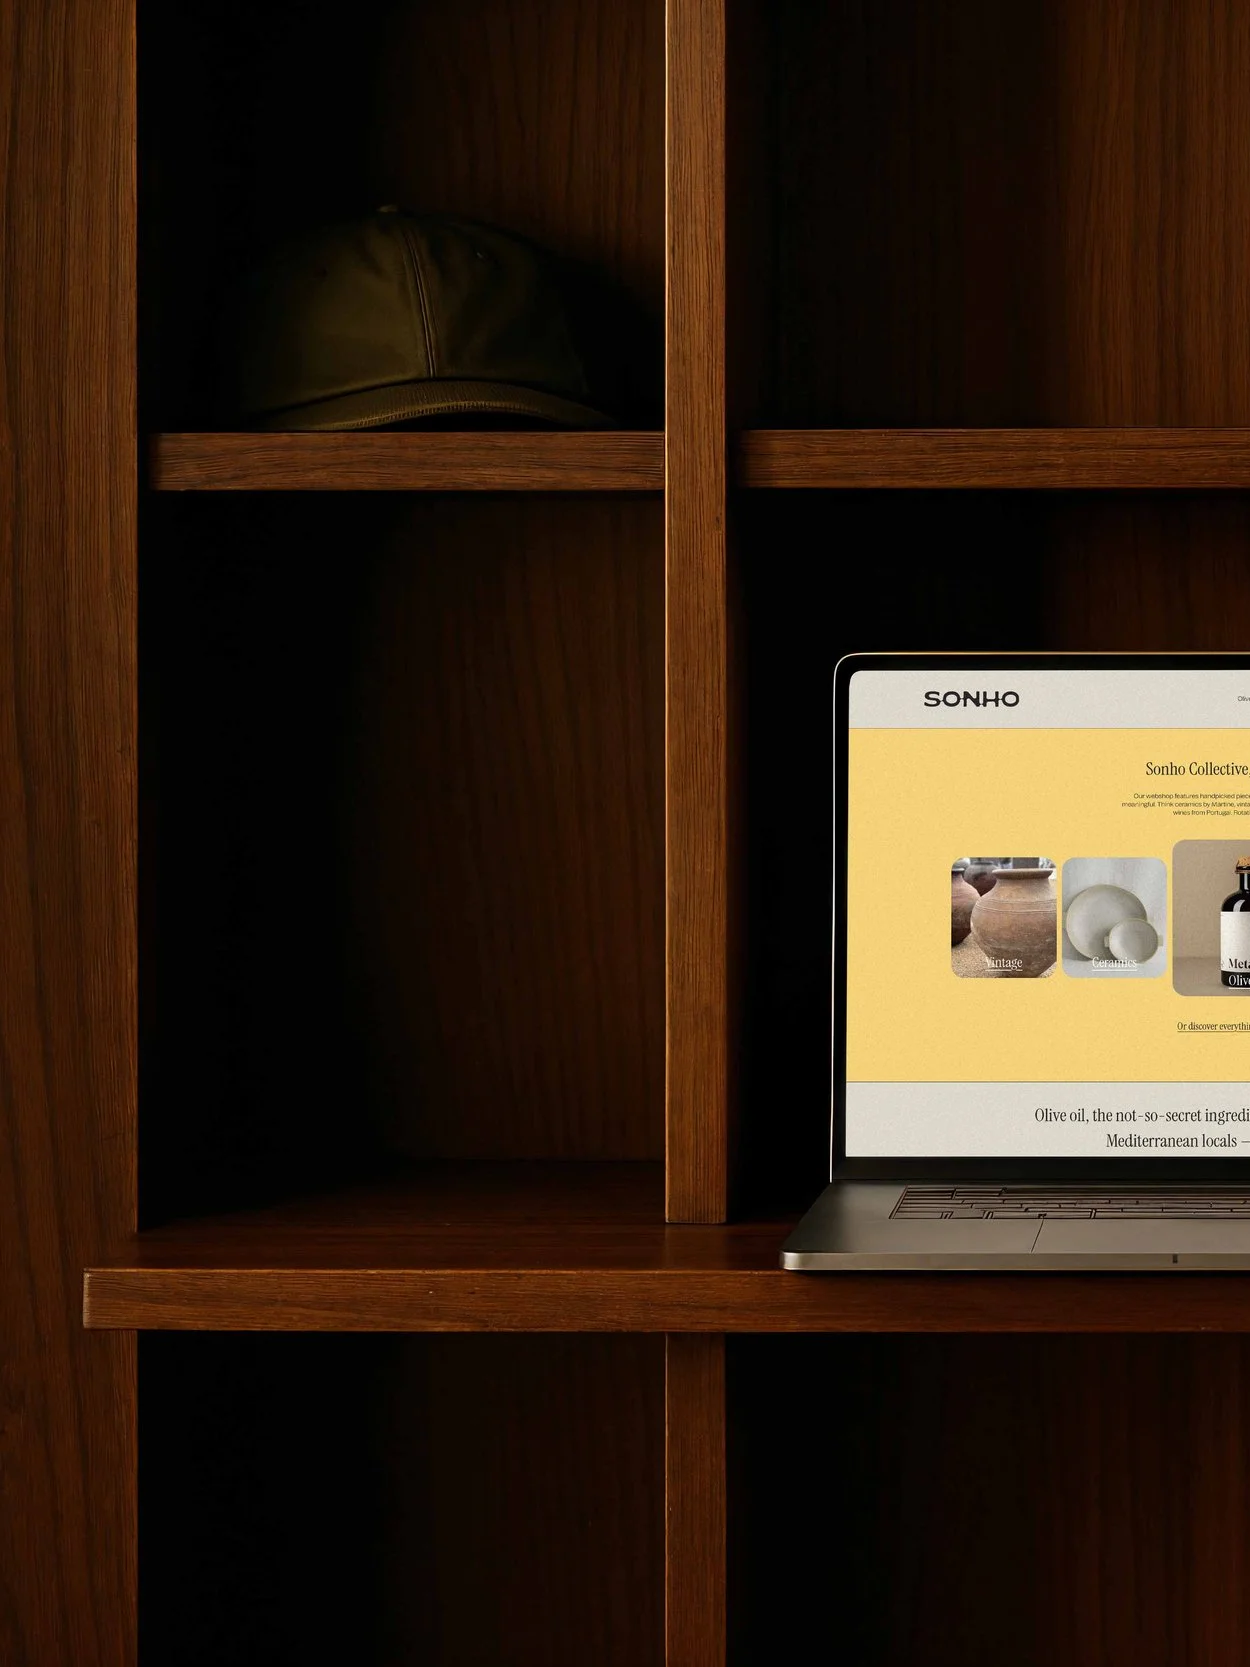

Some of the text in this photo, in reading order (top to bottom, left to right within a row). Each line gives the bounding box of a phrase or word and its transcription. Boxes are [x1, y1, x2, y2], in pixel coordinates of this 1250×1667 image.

[923, 690, 1020, 708] SONHO
[1145, 761, 1186, 776] Sonho
[1146, 793, 1173, 801] webshop
[1200, 793, 1235, 801] handpicked
[1203, 801, 1211, 809] by
[1206, 809, 1233, 817] Portugal.
[985, 956, 1023, 970] Vintage
[1091, 956, 1137, 969] Ceramics
[1177, 1021, 1187, 1031] Or
[1188, 1021, 1218, 1031] discover
[1034, 1107, 1067, 1123] Olive
[1069, 1107, 1090, 1125] oil,
[1093, 1107, 1113, 1123] the
[1115, 1107, 1202, 1123] not-so-secret
[1106, 1133, 1199, 1148] Mediterranean
[1201, 1133, 1238, 1148] locals
